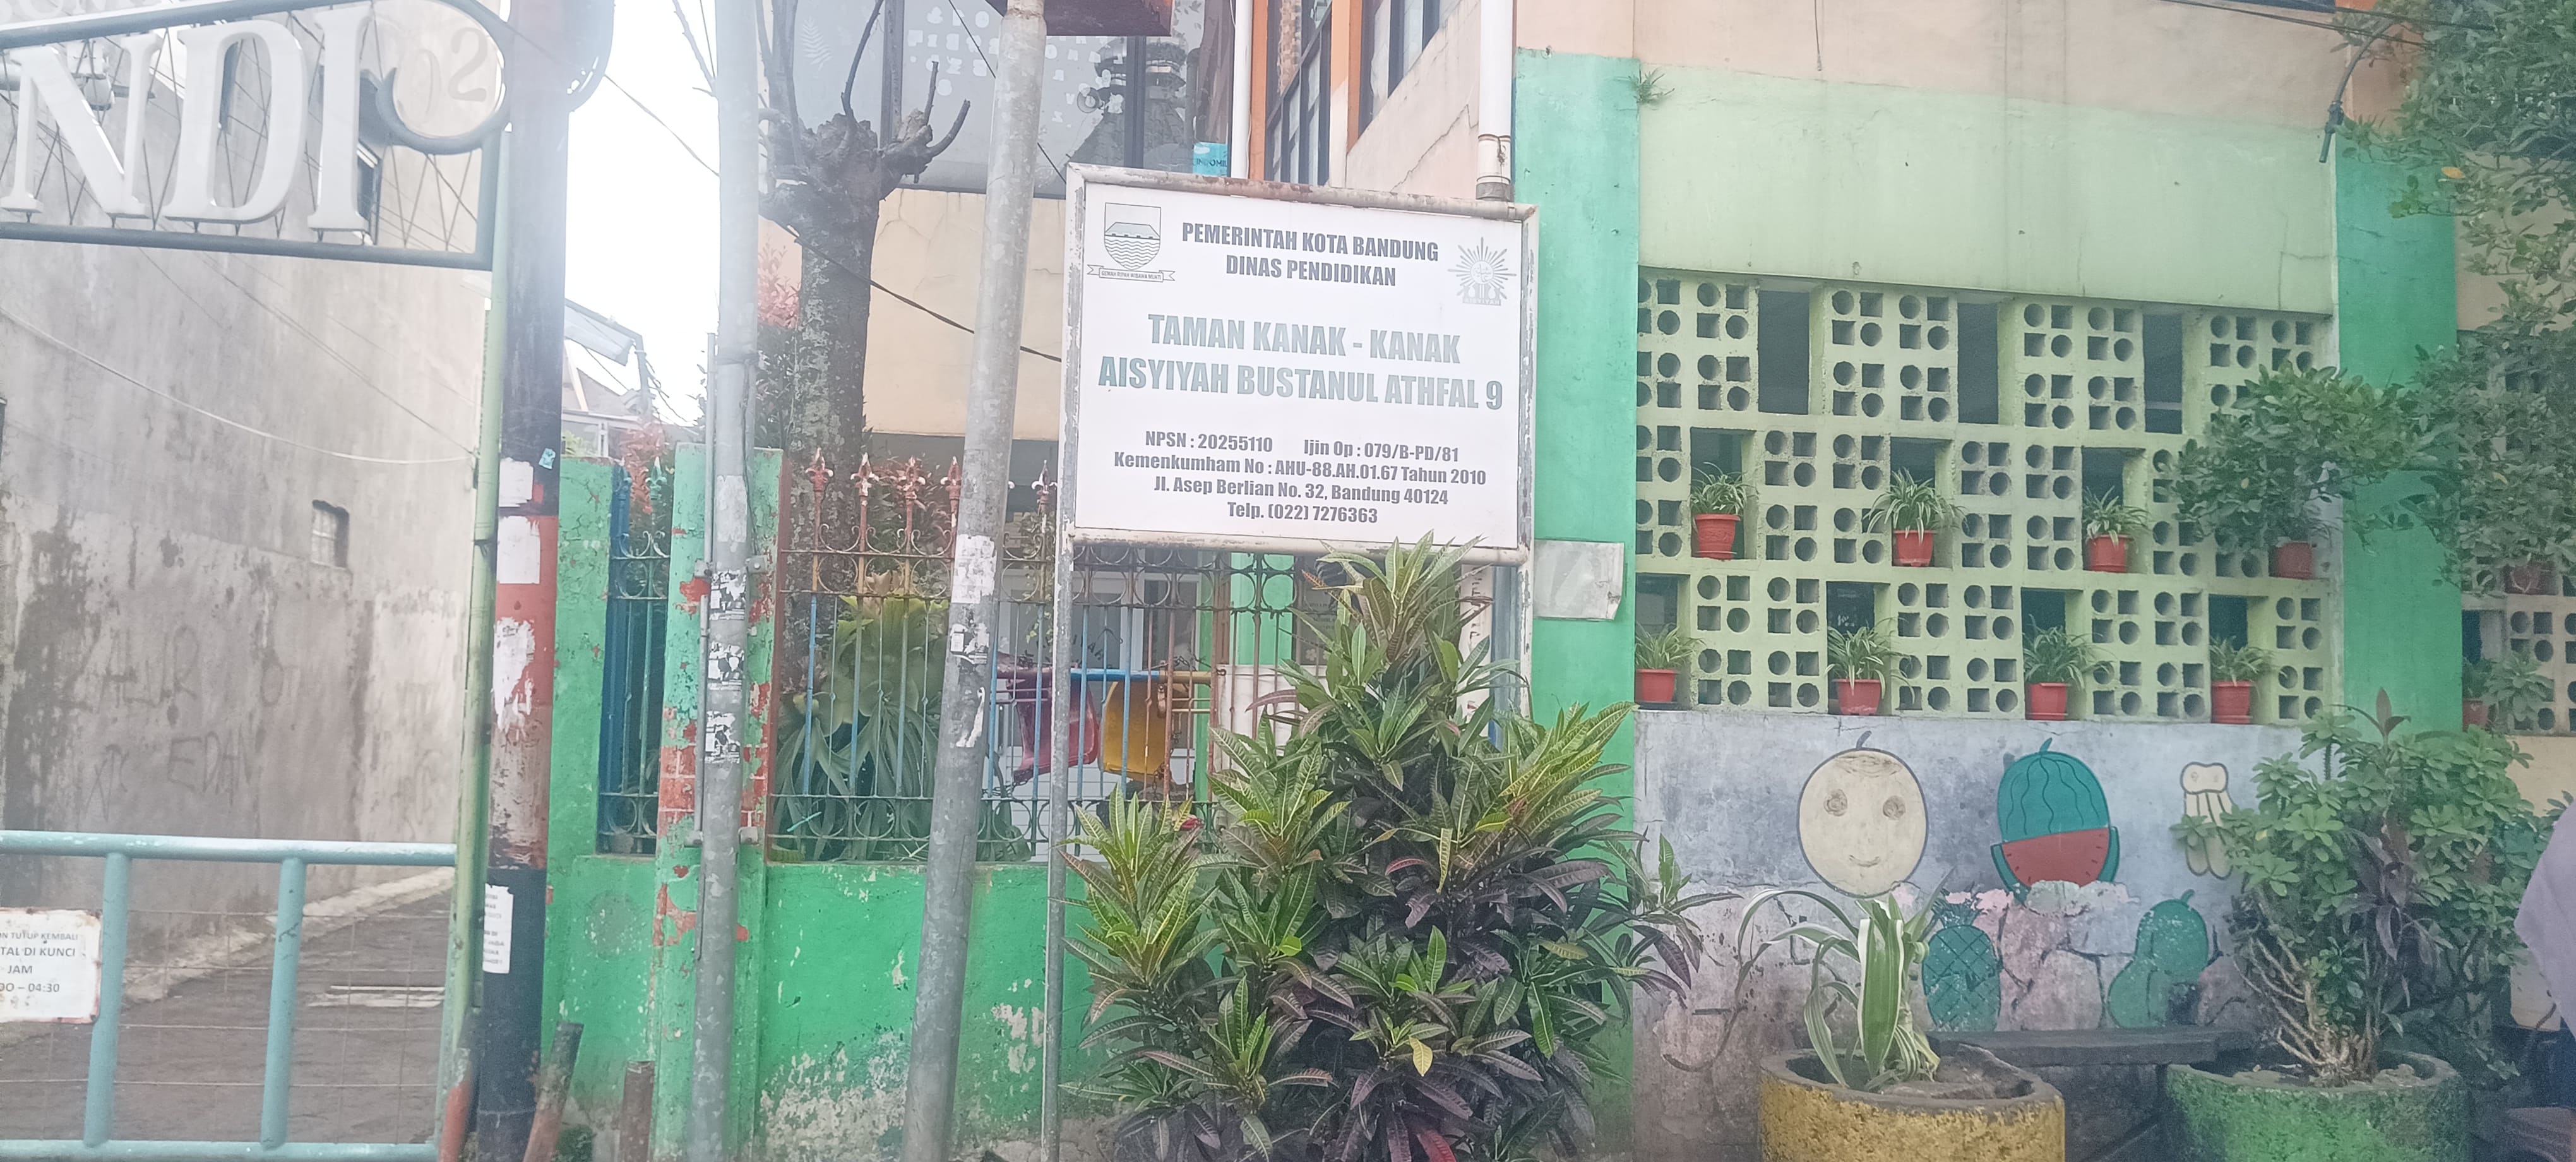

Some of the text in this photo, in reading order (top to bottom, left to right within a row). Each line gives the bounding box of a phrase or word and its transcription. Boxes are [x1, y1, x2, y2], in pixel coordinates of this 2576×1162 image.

[1182, 222, 1438, 262] PEMERINTAH KOTA BANDUNG
[1225, 255, 1396, 287] DINAS PENDIDIKAN
[1148, 313, 1245, 350] TAMAN
[1253, 321, 1347, 357] KANAK
[1369, 329, 1460, 364] KANAK
[1097, 356, 1503, 410] AISYIYAH BUSTANUL ATHFAL 9
[1145, 430, 1187, 448] NPSN
[1197, 433, 1273, 453] 20255110
[1304, 439, 1330, 457] Ijin
[1333, 440, 1354, 458] Op
[1364, 442, 1458, 462] 079/B-PD/81
[1114, 451, 1241, 473] Kemenkumham
[1244, 458, 1264, 474] No
[1274, 460, 1398, 481] AHU-88.AH.01.67
[1400, 466, 1447, 483] Tahun
[1450, 469, 1486, 486] 2010
[1154, 476, 1449, 505] Jl. Asep Berlian No. 32, Bandung 40124
[1227, 501, 1378, 524] Telp. (022) 7276363
[11, 931, 39, 940] TUTUP
[41, 932, 78, 940] KEMBALI
[24, 947, 36, 956] DI
[40, 947, 75, 957] KUNCI
[7, 965, 33, 974] JAM
[28, 983, 60, 993] 04:30
